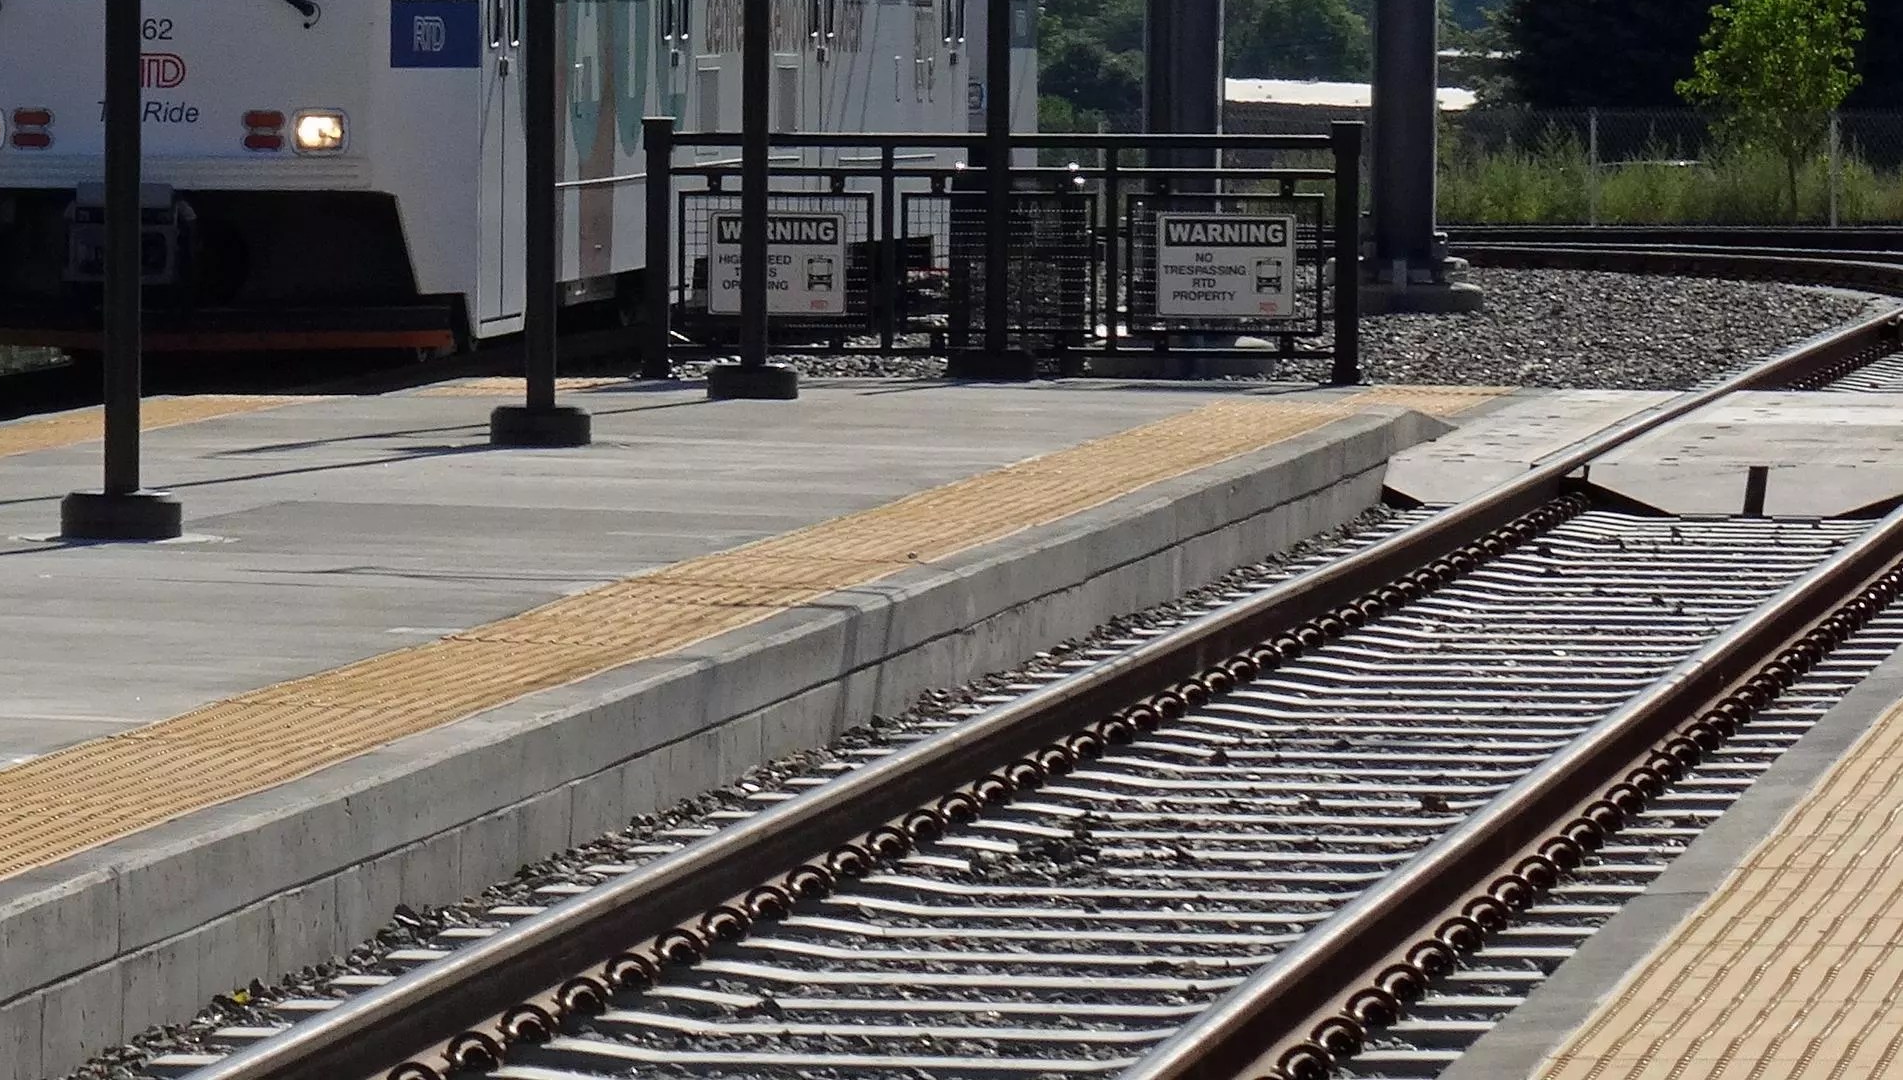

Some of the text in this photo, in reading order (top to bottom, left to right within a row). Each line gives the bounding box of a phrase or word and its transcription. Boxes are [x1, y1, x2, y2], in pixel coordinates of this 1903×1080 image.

[142, 18, 173, 40] 62
[414, 15, 446, 52] RTD
[140, 52, 186, 88] TD
[142, 101, 200, 123] Ride
[1169, 222, 1284, 243] WARNING
[1195, 252, 1213, 263] NO
[1163, 265, 1247, 276] TRESPASSING
[1192, 278, 1217, 289] RTD
[1172, 290, 1236, 301] PROPERTY
